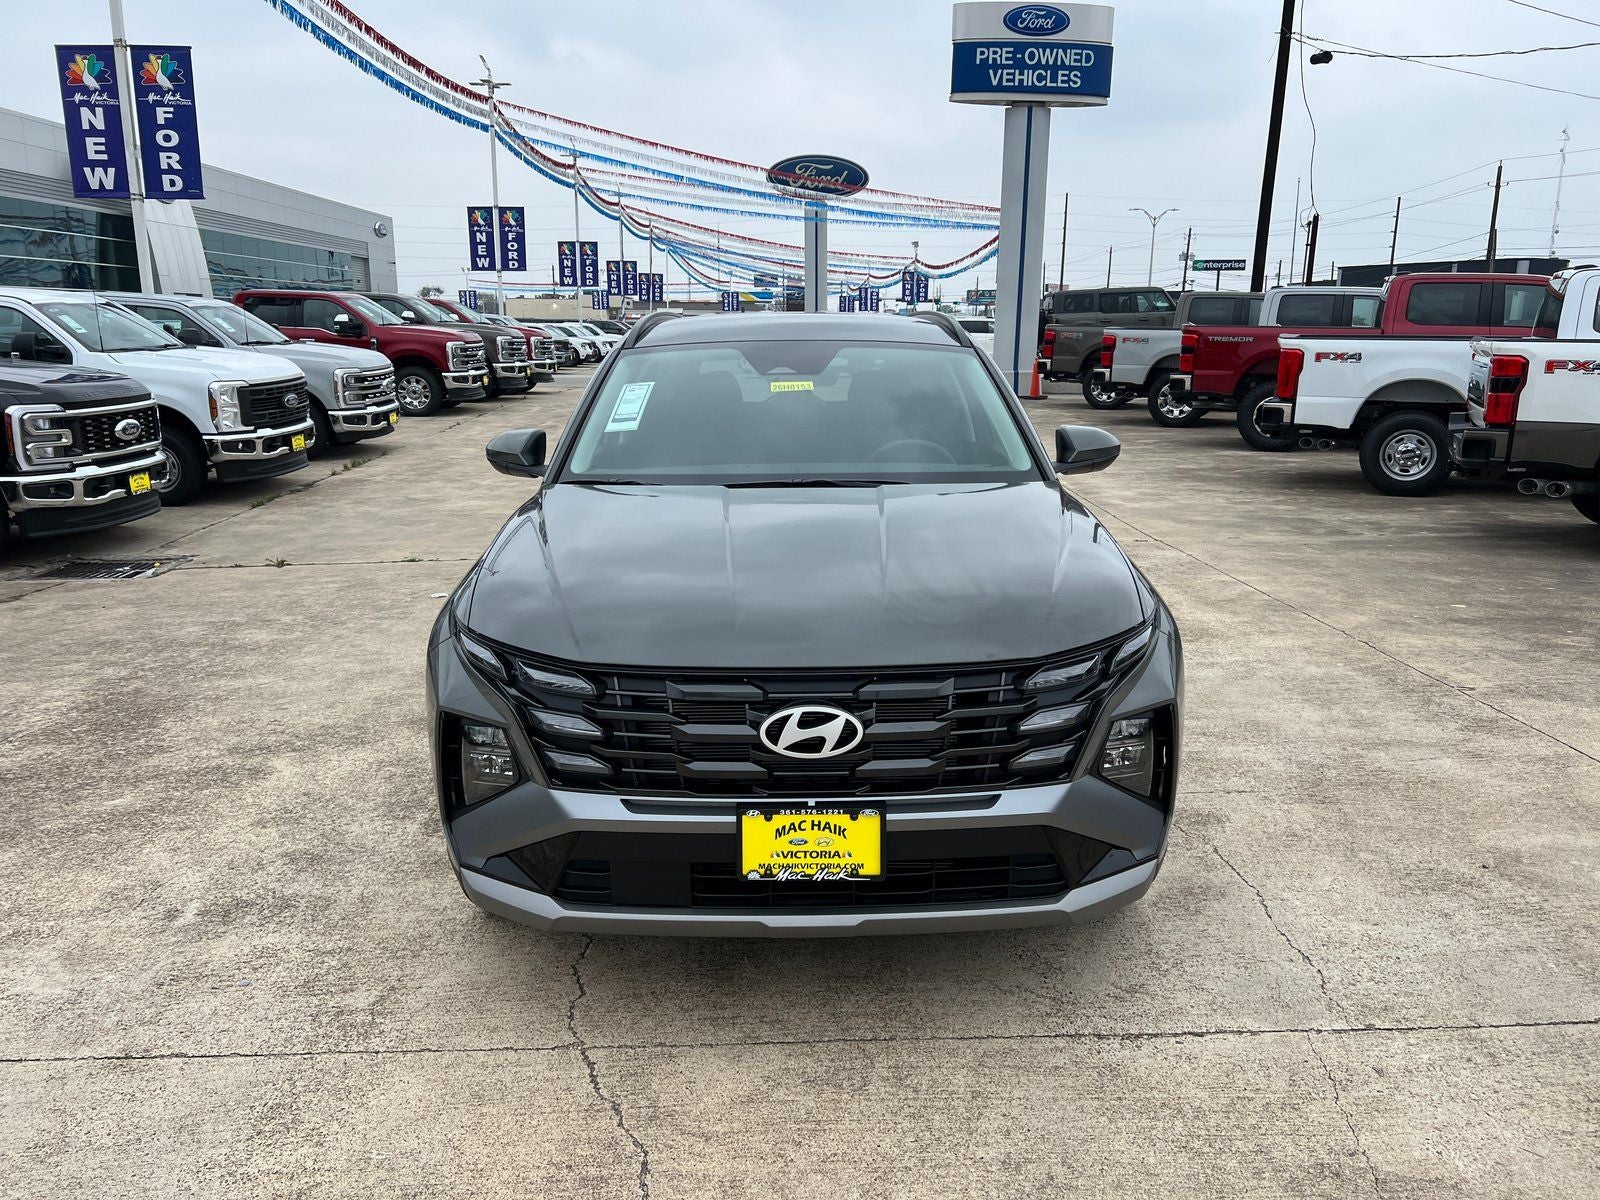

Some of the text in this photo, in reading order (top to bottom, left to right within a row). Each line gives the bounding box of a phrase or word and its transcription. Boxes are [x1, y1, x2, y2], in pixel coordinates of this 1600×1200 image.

[1017, 10, 1056, 29] Ford
[989, 69, 1082, 88] VEHICLES
[80, 106, 115, 190] NEW
[155, 106, 183, 191] FORD
[789, 162, 848, 188] Ford
[475, 232, 490, 268] NEW
[507, 232, 518, 269] FORD
[564, 259, 573, 285] NEW
[585, 260, 593, 285] FORD
[1195, 260, 1246, 269] enterprise
[610, 274, 618, 294] NEW
[1314, 352, 1362, 362] FX4
[774, 820, 848, 840] MAC HAIK
[780, 850, 842, 859] VICTORIA
[774, 867, 854, 881] Mac Haik
